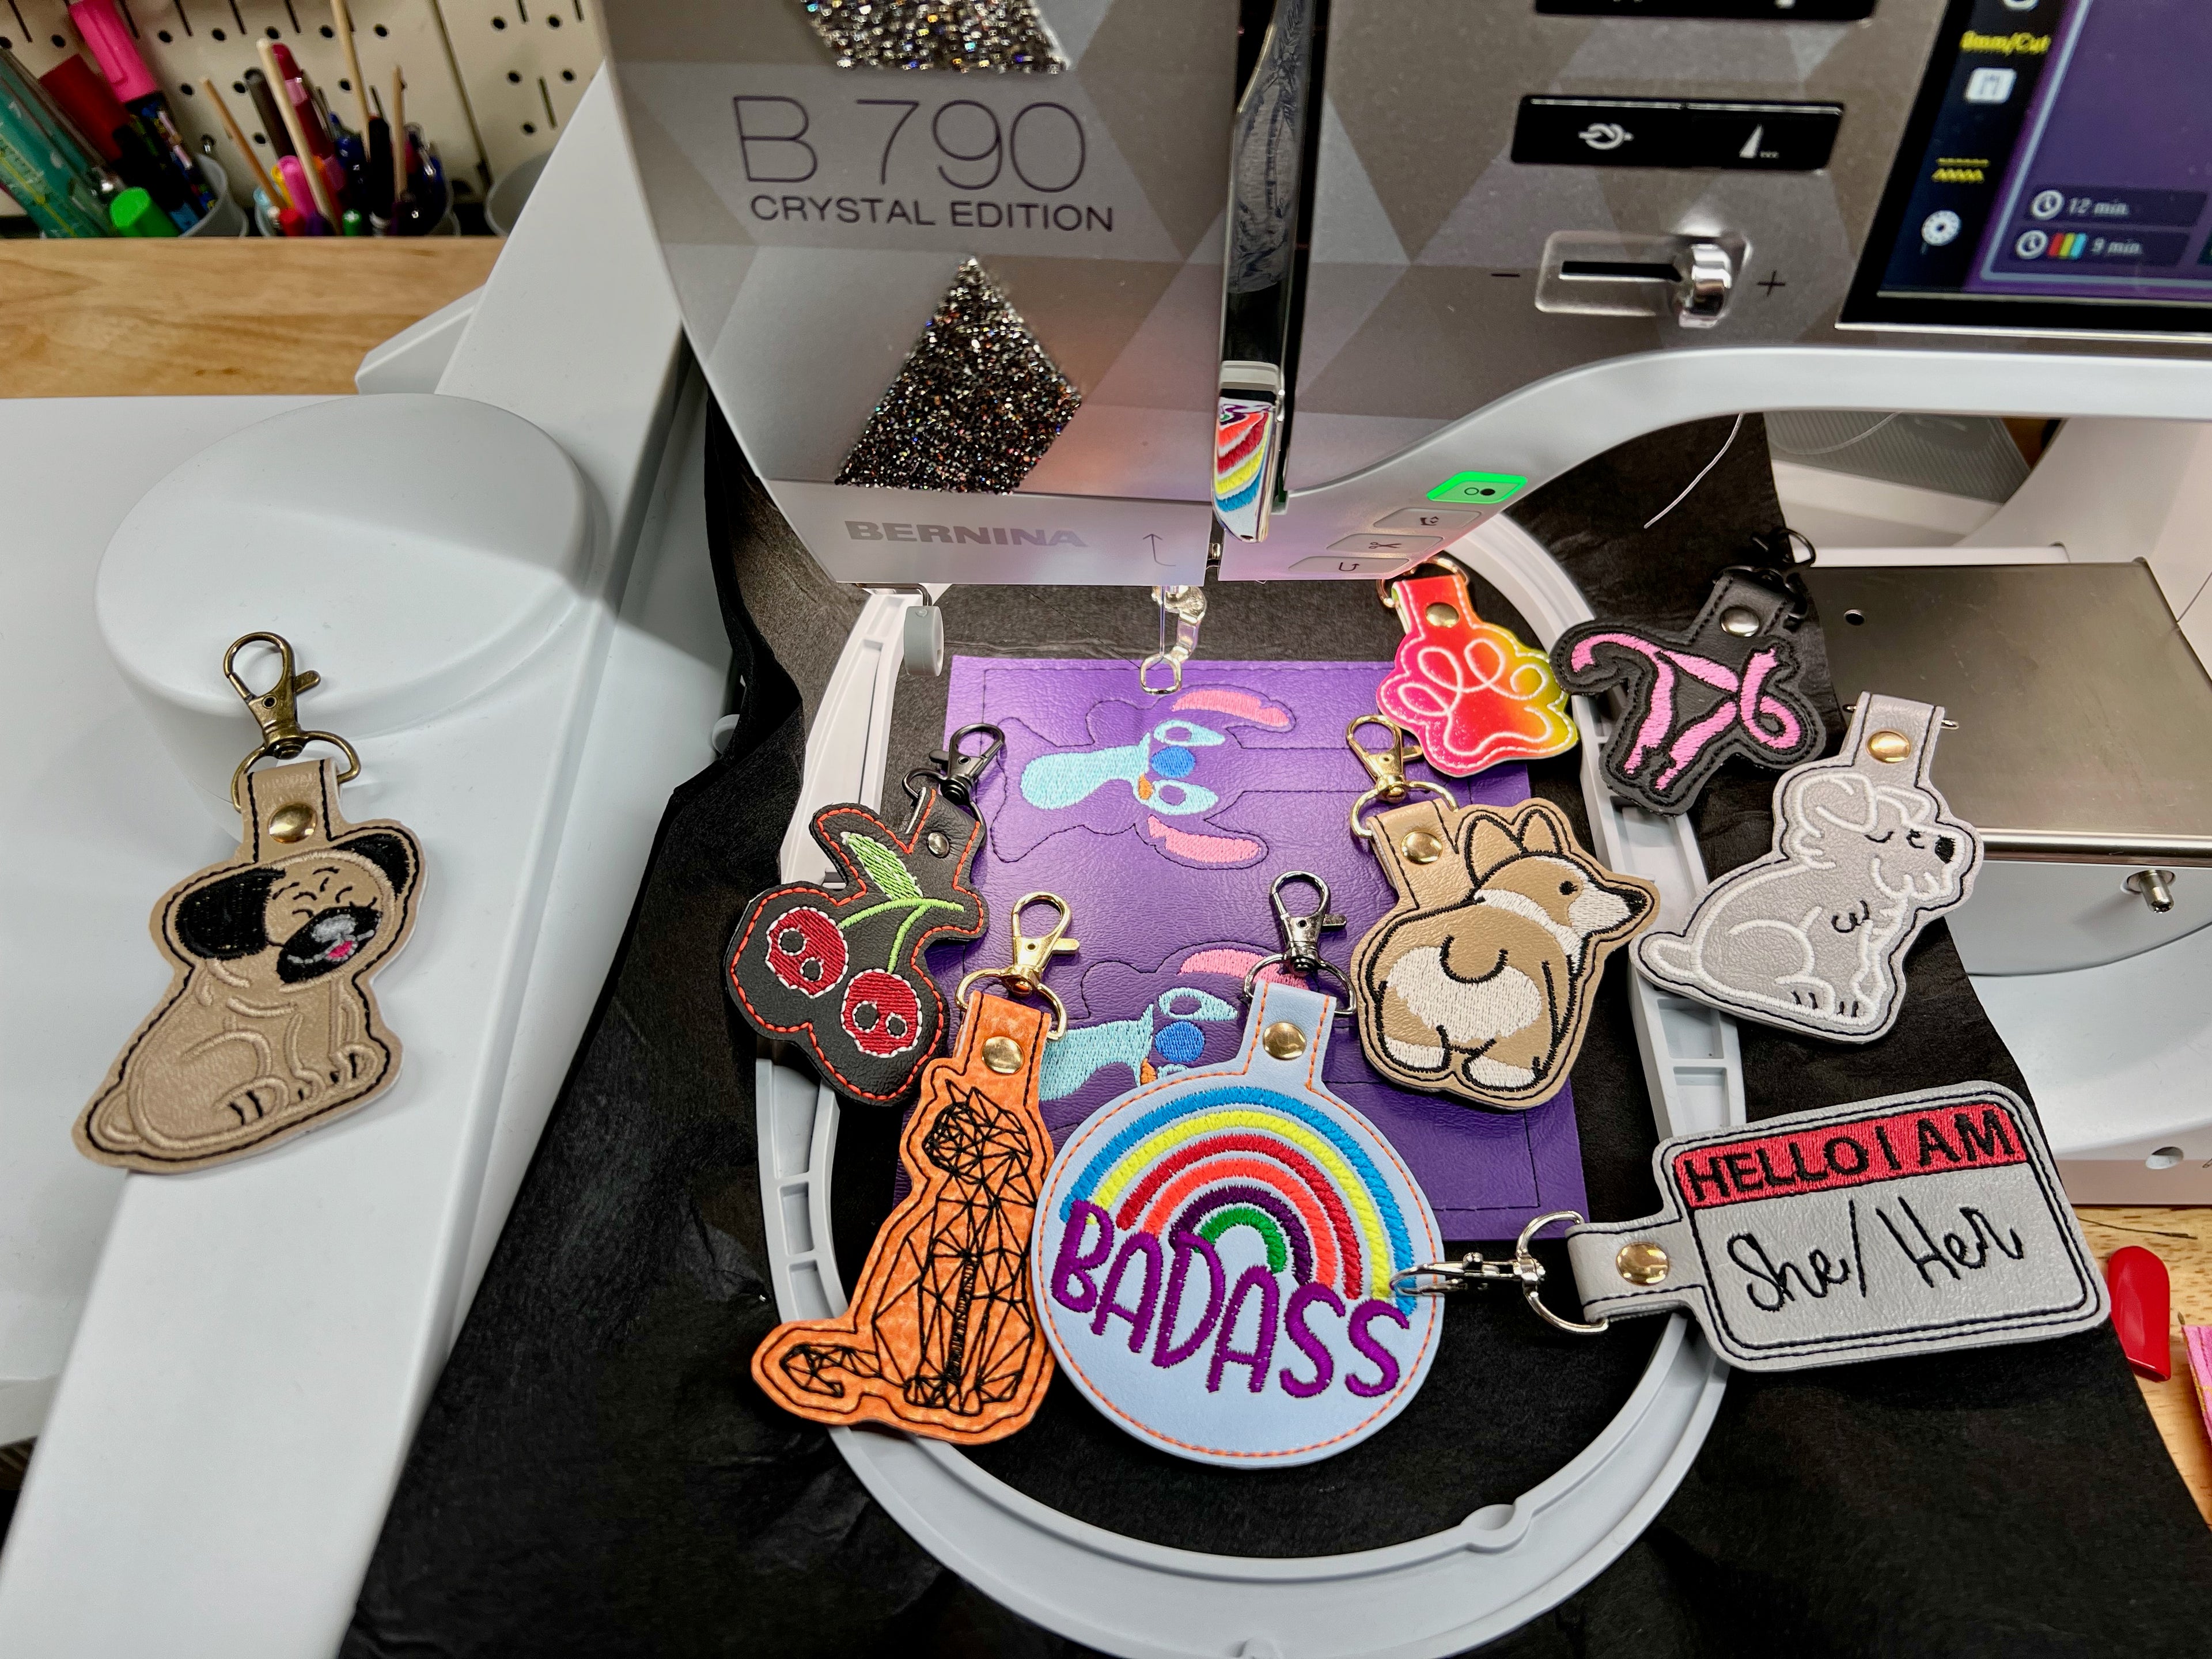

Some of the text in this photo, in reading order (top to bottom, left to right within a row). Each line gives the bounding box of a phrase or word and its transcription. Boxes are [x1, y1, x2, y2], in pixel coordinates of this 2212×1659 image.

[733, 95, 1086, 193] B 790
[750, 194, 1113, 232] CRYSTAL EDITION
[2069, 197, 2092, 217] 12
[2090, 236, 2105, 255] 9
[844, 520, 1088, 547] BERNINA
[1684, 1109, 2015, 1202] HELLO I AM
[1051, 1199, 1410, 1399] BADASS
